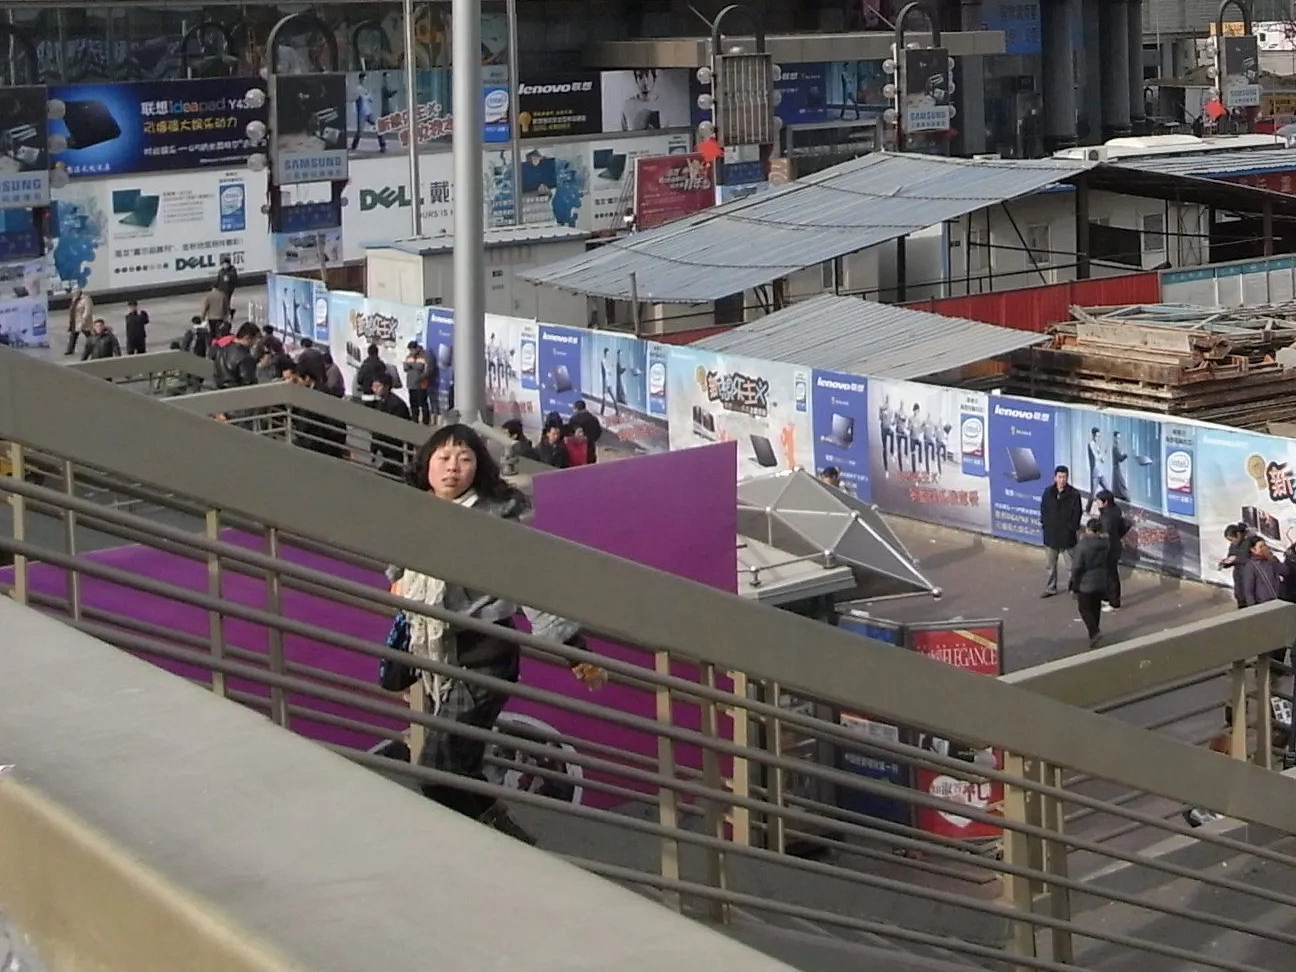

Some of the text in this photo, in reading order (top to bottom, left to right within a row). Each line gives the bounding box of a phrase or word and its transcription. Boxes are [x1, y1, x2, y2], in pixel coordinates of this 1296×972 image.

[910, 111, 947, 120] SAMSUNG
[284, 156, 342, 170] SAMSUNG
[359, 185, 424, 211] DEL
[176, 255, 216, 271] DELL
